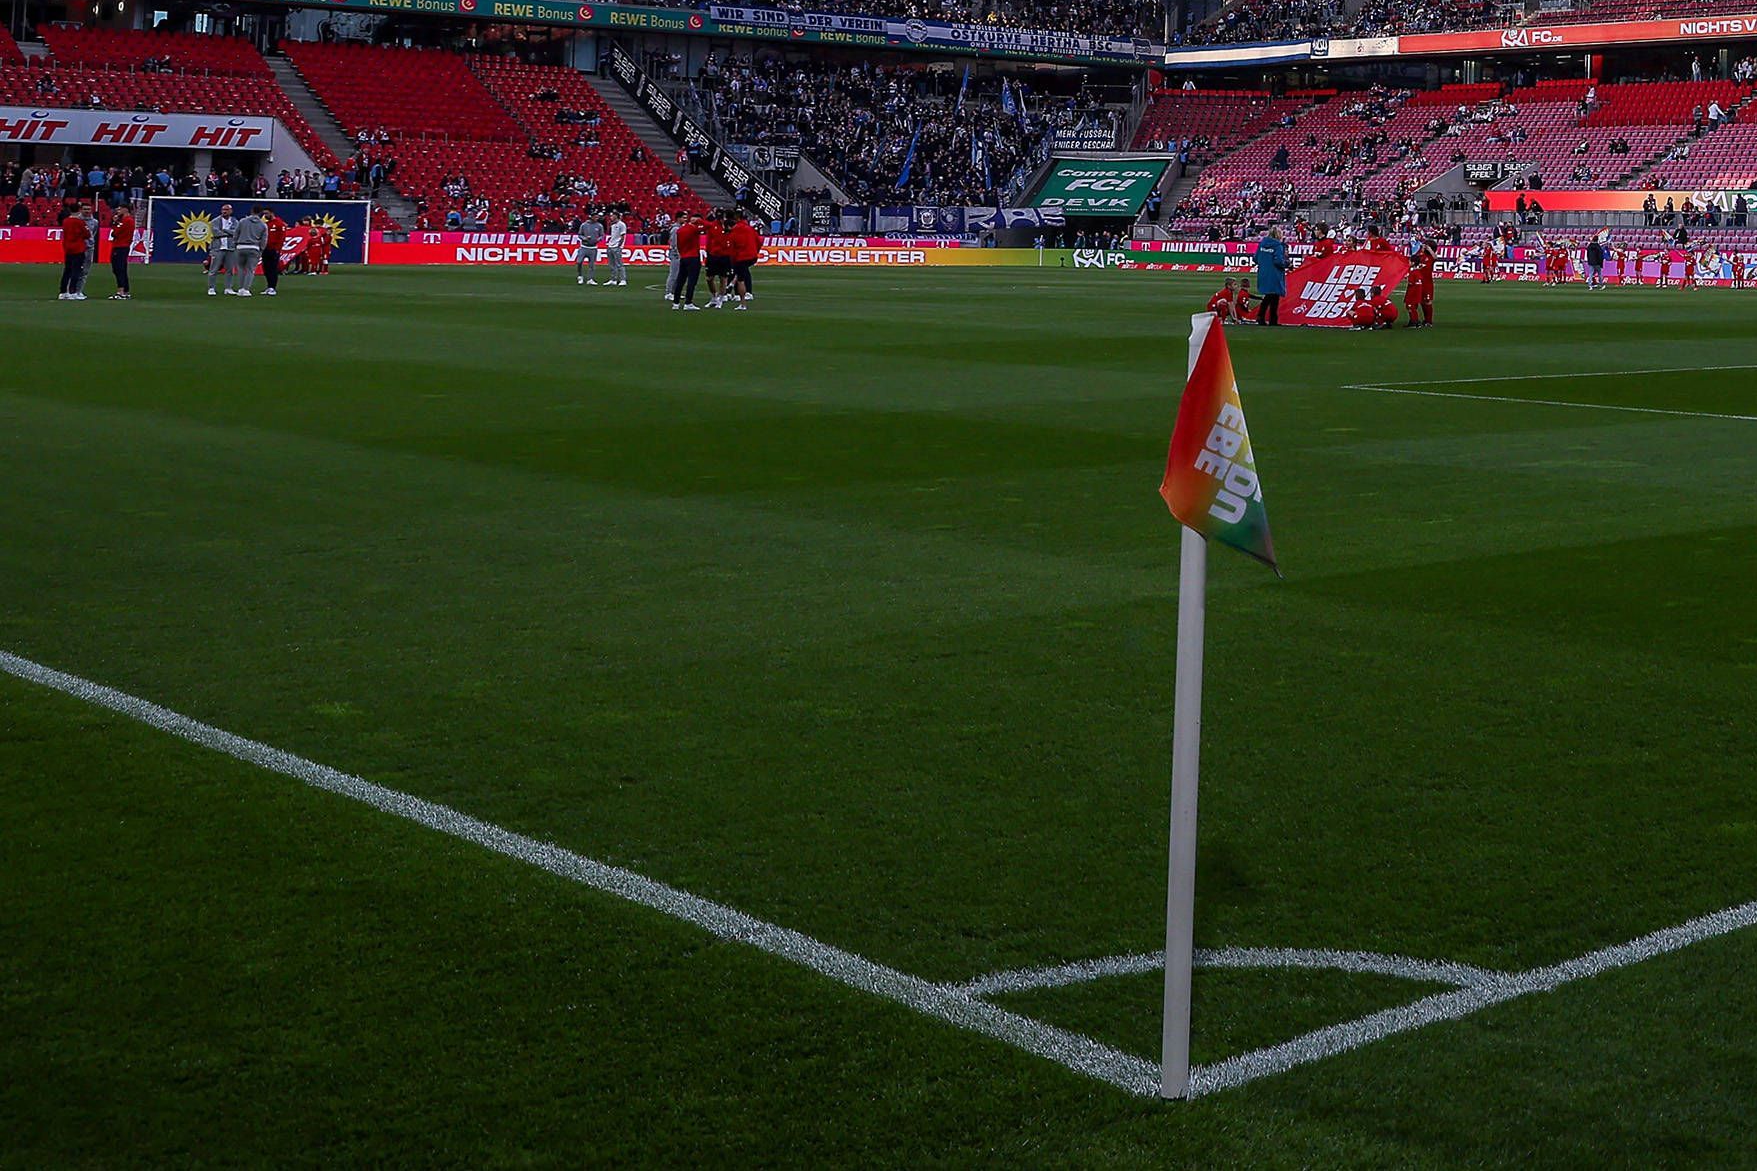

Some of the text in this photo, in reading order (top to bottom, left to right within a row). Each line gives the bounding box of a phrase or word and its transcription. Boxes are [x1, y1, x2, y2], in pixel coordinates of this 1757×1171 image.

[494, 2, 574, 21] REWE Bonus
[717, 7, 786, 23] WIR SIND
[610, 11, 685, 29] REWE Bonus
[808, 15, 833, 27] DER
[839, 17, 883, 31] VEREIN
[1679, 20, 1743, 35] NICHTS
[951, 29, 1113, 52] OSTKURVE HERTHA BSC
[90, 122, 168, 144] HIT
[188, 126, 263, 147] HIT
[1056, 129, 1115, 138] MEHR FUSSBALL
[1051, 140, 1081, 149] ENIGER
[1057, 169, 1154, 178] Come on,
[1466, 163, 1493, 171] SILBER
[1064, 178, 1136, 191] FC!
[1040, 198, 1131, 207] DEVK
[456, 247, 558, 263] NICHTS
[1325, 264, 1381, 285] LEBE
[1300, 281, 1347, 301] WIE
